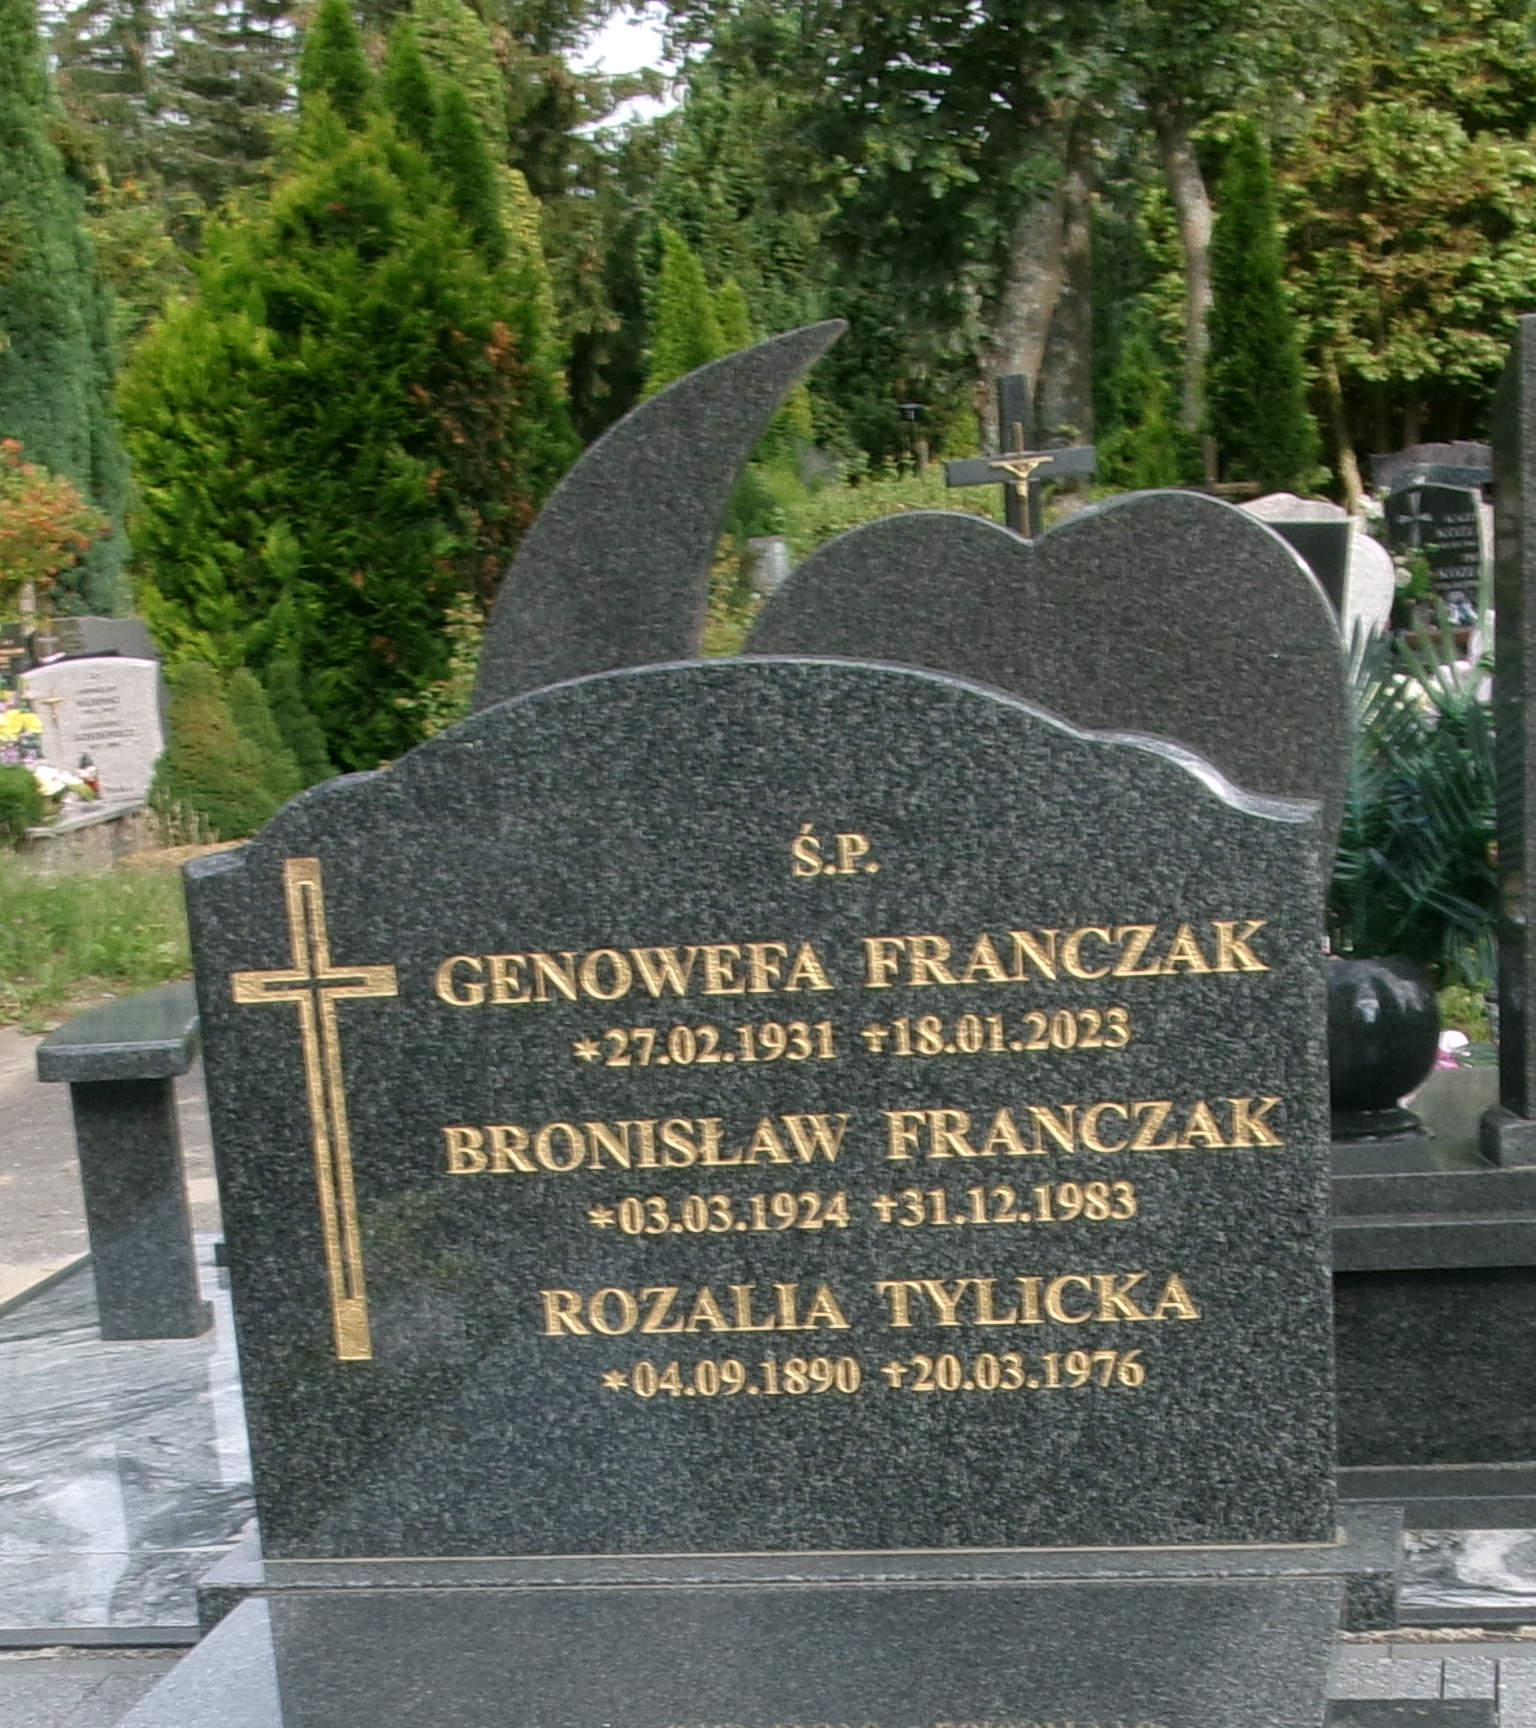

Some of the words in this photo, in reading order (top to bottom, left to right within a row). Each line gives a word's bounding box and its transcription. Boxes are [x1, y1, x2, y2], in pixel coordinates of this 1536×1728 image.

[790, 823, 881, 878] Ś.P.
[434, 939, 835, 1007] GENOWEFA
[864, 918, 1270, 988] FRANCZAK
[443, 1111, 850, 1175] BRONISŁAW
[884, 1095, 1284, 1161] FRANCZAK
[540, 1281, 851, 1337] ROZALIA
[875, 1270, 1201, 1329] TYLICKA
